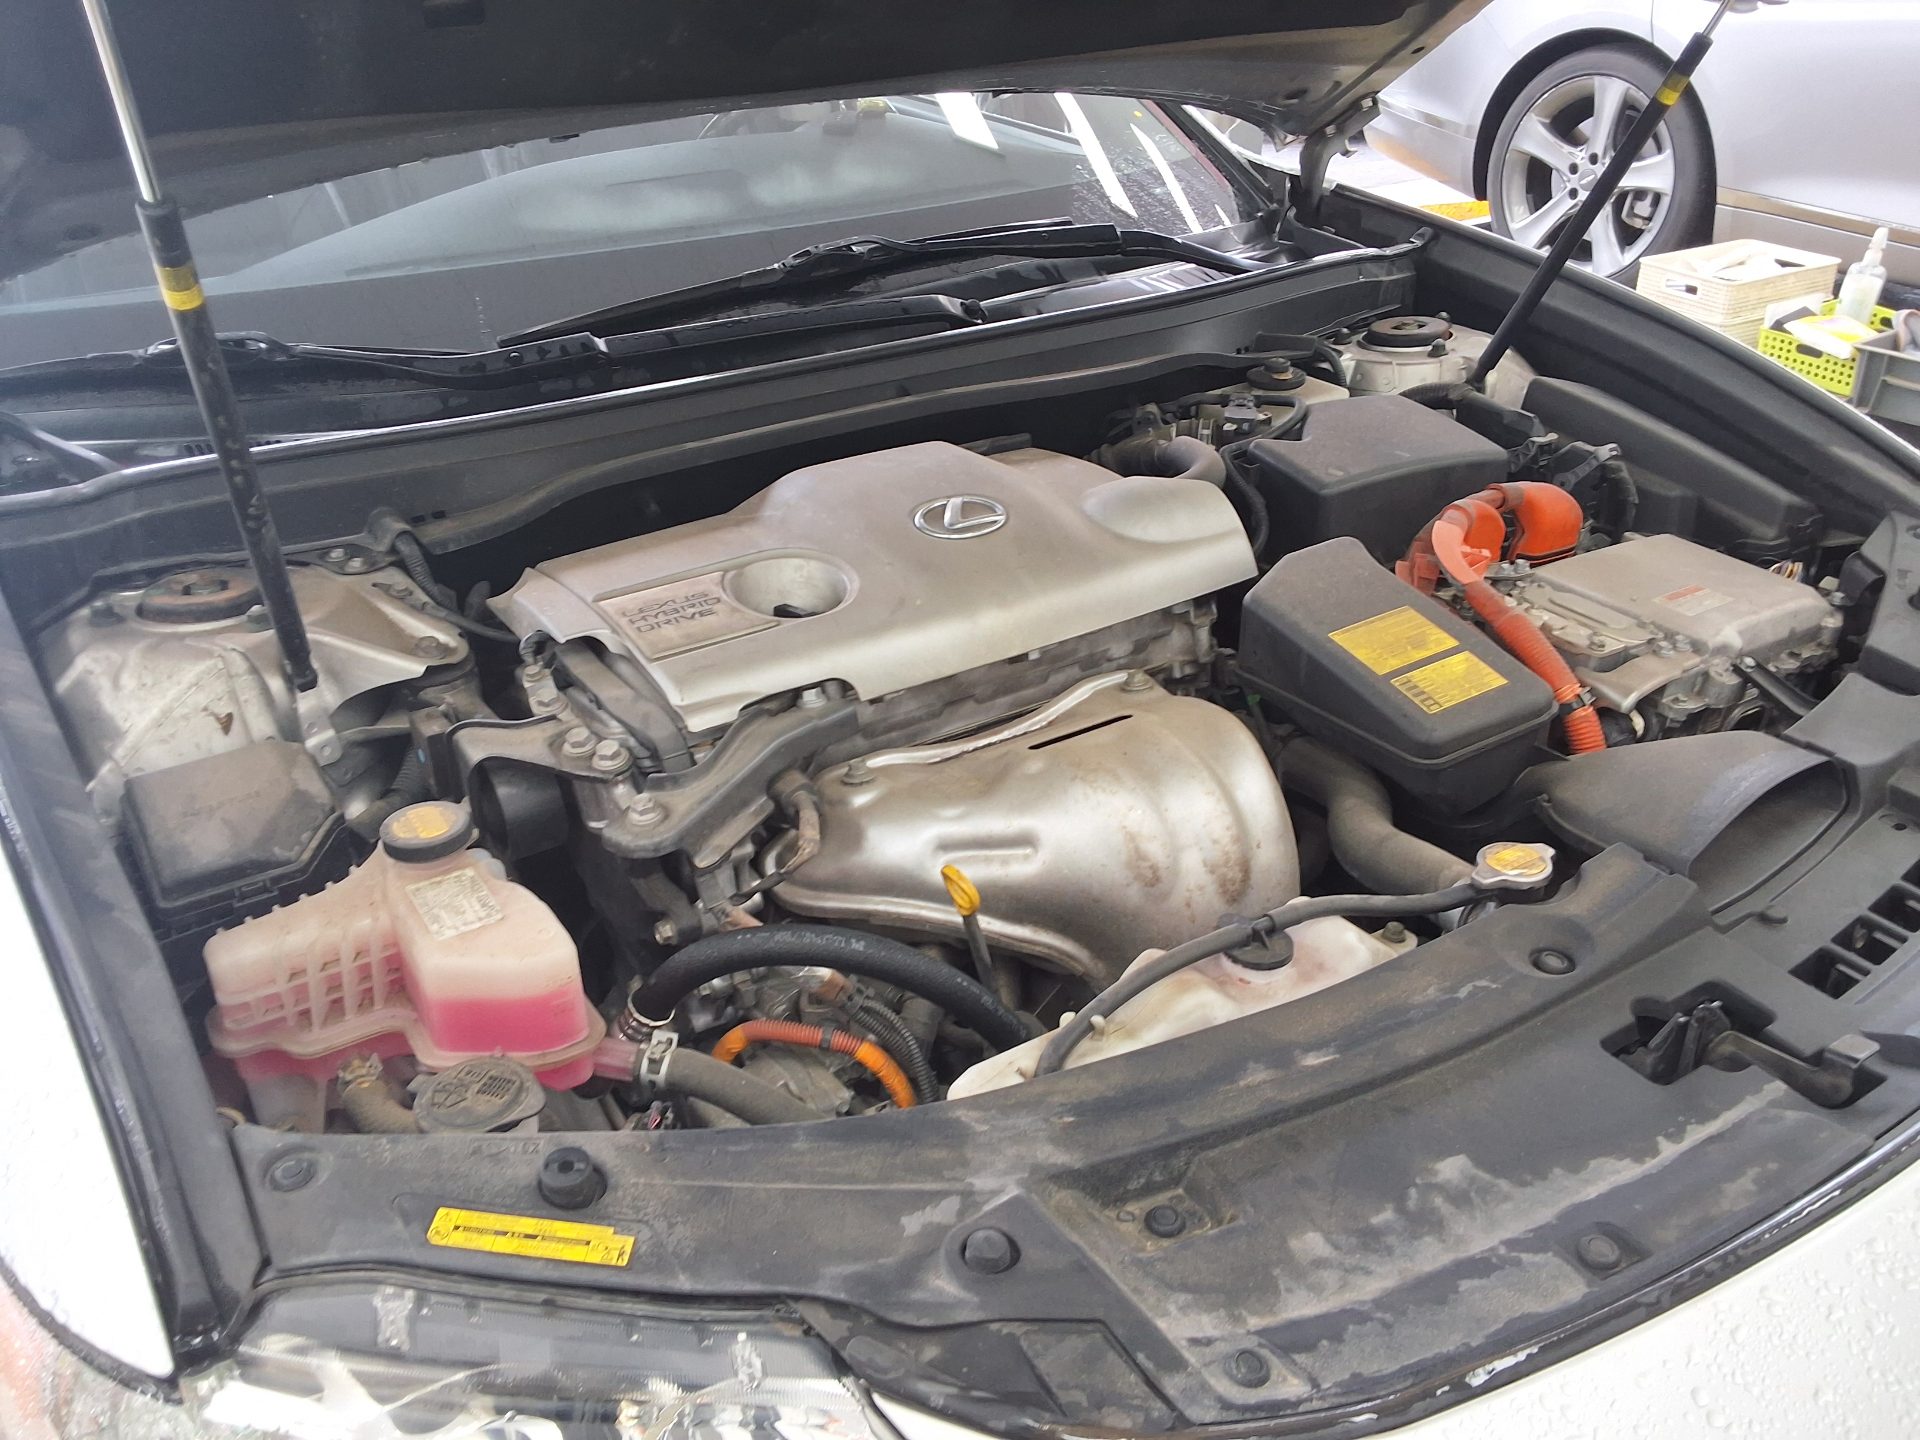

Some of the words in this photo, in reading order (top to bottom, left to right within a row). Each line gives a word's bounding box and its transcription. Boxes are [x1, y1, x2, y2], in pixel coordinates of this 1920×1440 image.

[621, 592, 710, 617] LEXUS
[628, 596, 721, 625] HYBRID
[636, 607, 718, 633] DRIVE
